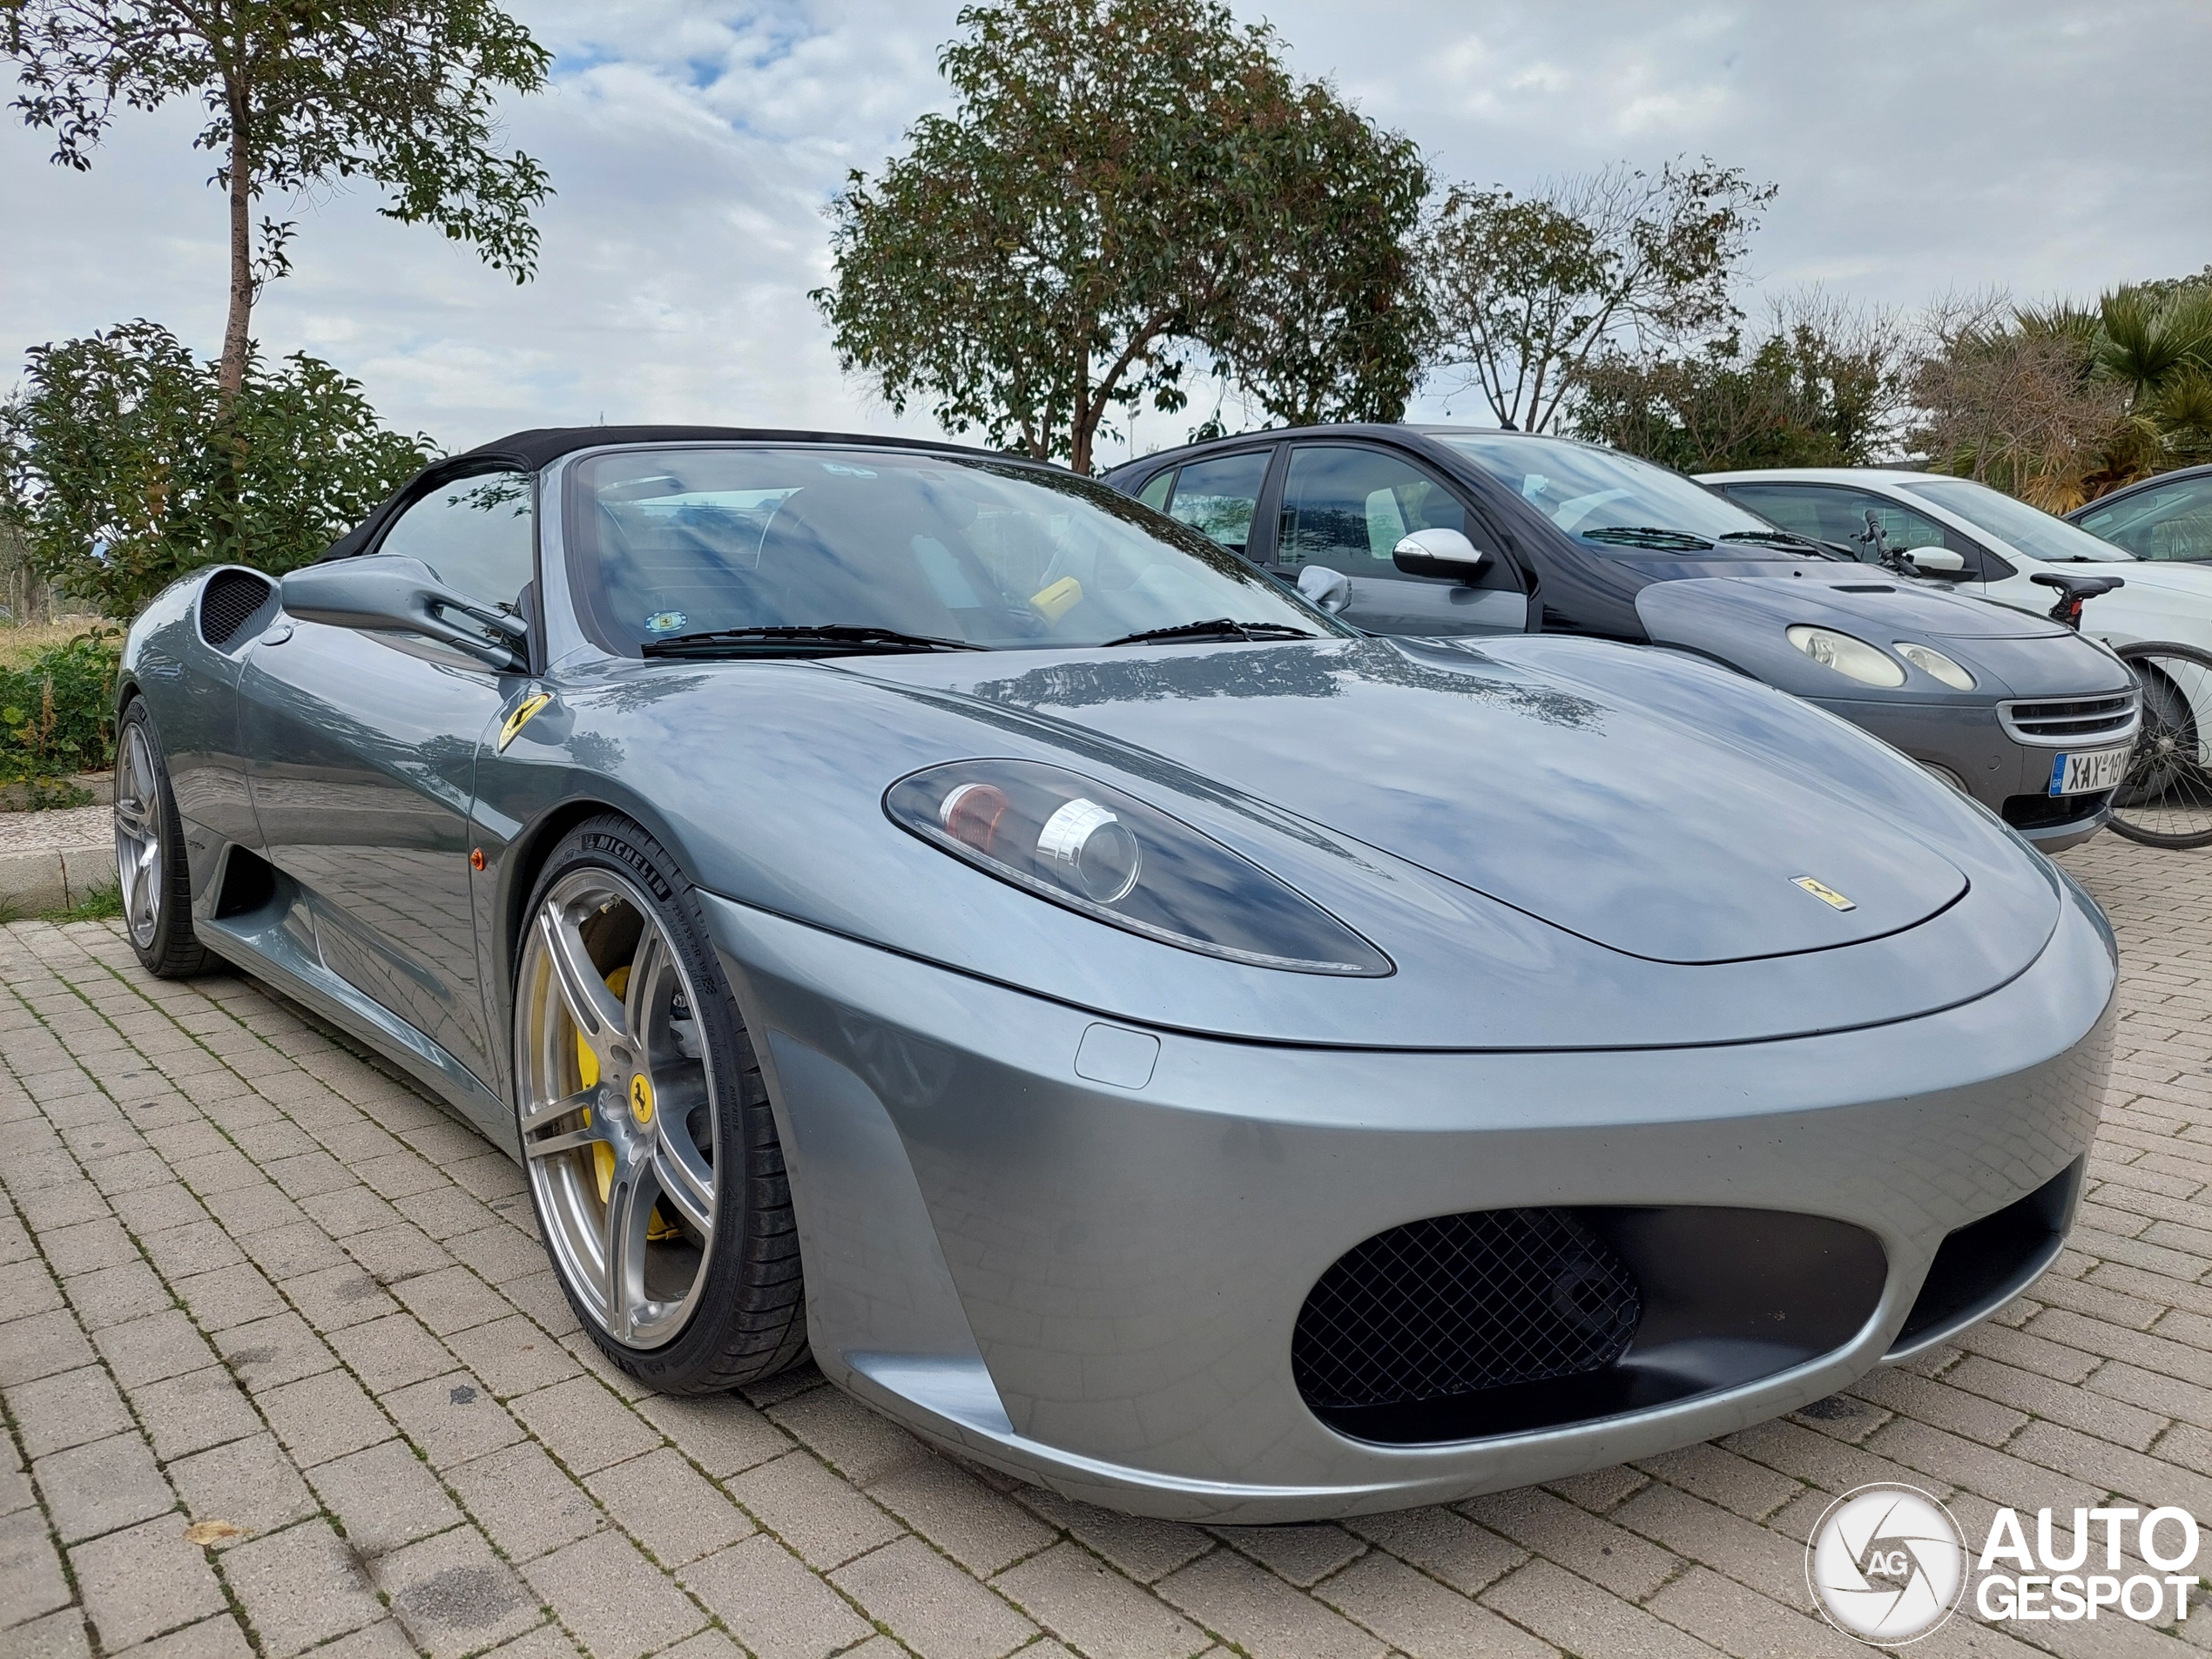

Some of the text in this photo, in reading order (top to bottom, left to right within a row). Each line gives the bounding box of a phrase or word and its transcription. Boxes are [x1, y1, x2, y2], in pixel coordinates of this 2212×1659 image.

[2052, 779, 2062, 788] GR
[596, 835, 668, 896] MICHELIN
[672, 904, 707, 973] 235/35 ZR 19
